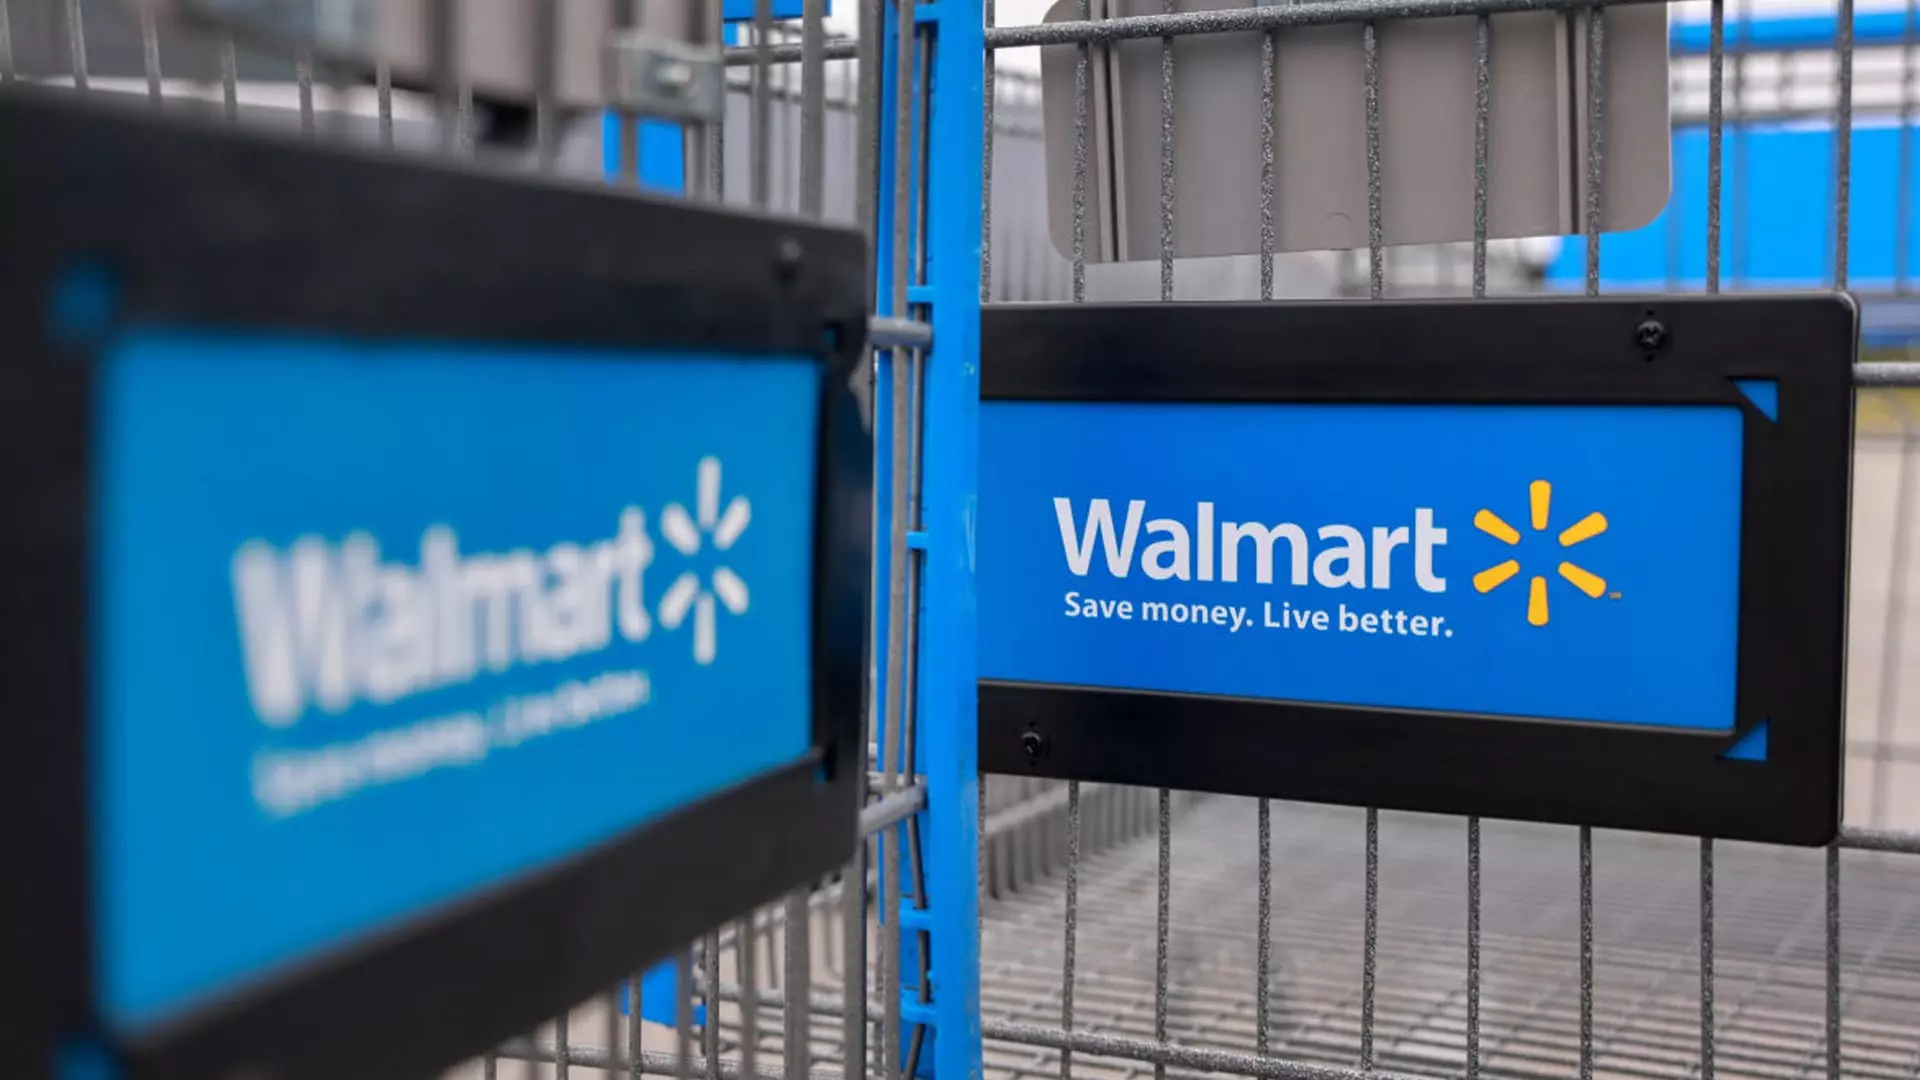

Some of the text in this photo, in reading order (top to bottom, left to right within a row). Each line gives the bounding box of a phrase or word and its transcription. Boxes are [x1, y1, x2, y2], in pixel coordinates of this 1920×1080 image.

[1054, 497, 1448, 593] Walmart
[233, 506, 653, 725] Walmart
[1065, 591, 1453, 637] Save money. Live better.
